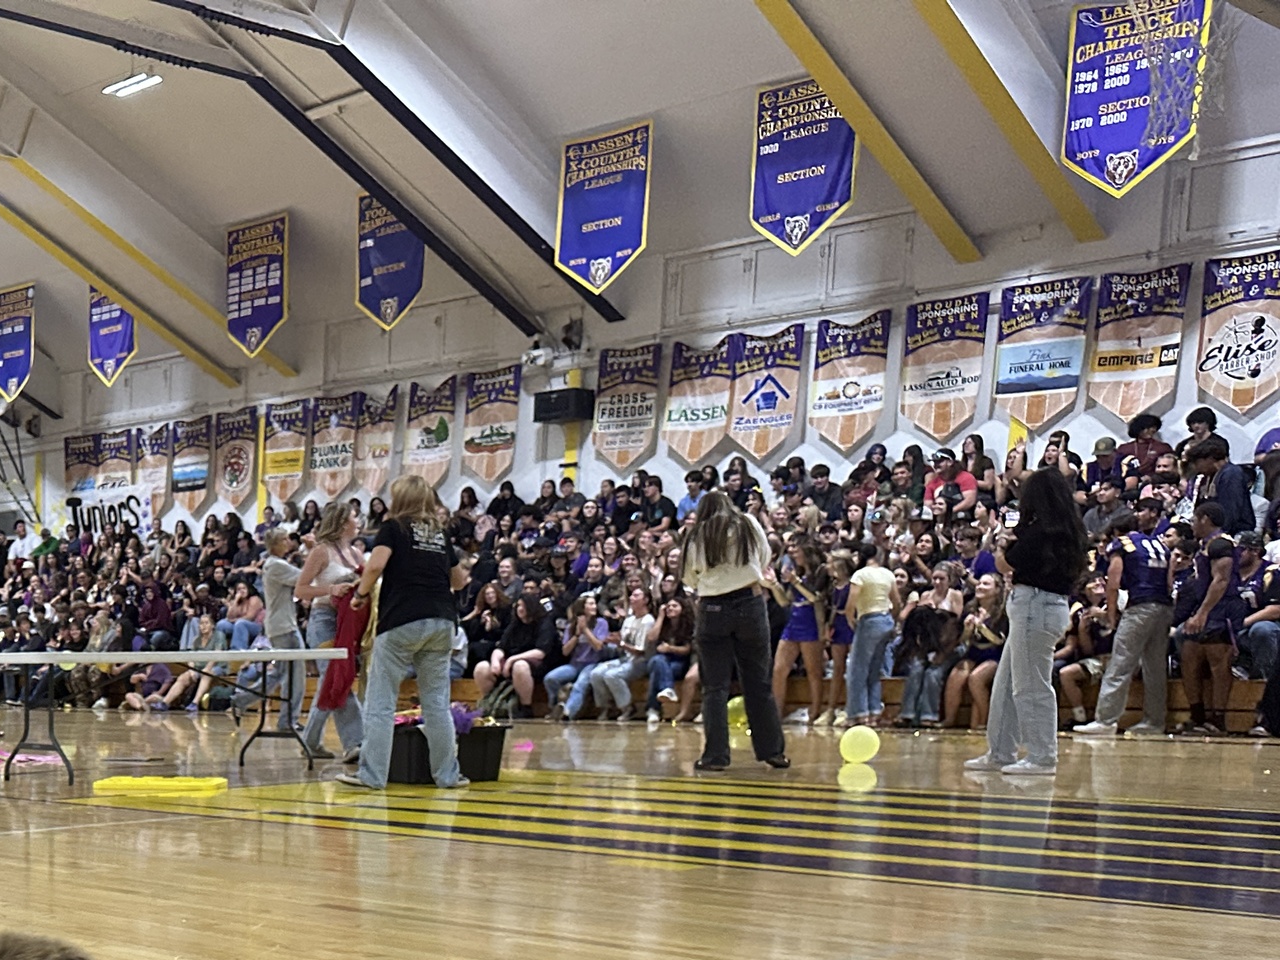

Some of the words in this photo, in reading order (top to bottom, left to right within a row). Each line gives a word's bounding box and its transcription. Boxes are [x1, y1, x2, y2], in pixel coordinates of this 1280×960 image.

[1104, 11, 1175, 39] TRACK
[1105, 43, 1164, 65] LEAG
[1075, 70, 1098, 82] 1964
[1105, 63, 1129, 77] 1965
[1104, 74, 1130, 90] 2000
[778, 83, 824, 102] LASS
[761, 97, 835, 123] X-COUNT
[1098, 95, 1157, 115] SECTIO
[759, 106, 843, 140] CHAMPIONSHI
[1100, 111, 1127, 126] 2000
[783, 122, 829, 140] LEAGUE
[582, 132, 633, 154] LASSEN
[569, 144, 642, 171] X-COUNTRY
[567, 155, 646, 187] CHAMPIONSHIPS
[777, 165, 826, 183] SECTION
[582, 216, 622, 233] SECTION
[1112, 268, 1179, 283] PROUDLY
[1219, 261, 1280, 277] SPONSORI
[1015, 280, 1080, 295] PROUDLY
[1111, 286, 1179, 300] LASSEN
[1112, 277, 1179, 292] SPONSORING
[1249, 284, 1260, 296] &
[917, 296, 978, 313] PROUDLY
[1012, 297, 1079, 312] LASSEN
[1013, 288, 1080, 304] SPONSORING
[917, 304, 978, 321] SPONSORING
[917, 312, 978, 328] LASSEN
[1161, 348, 1179, 361] CAT
[1199, 339, 1278, 372] Elise
[1219, 357, 1250, 372] BARBER
[1255, 350, 1277, 363] SHOP
[1009, 362, 1044, 374] FUNERAL
[1049, 361, 1071, 370] HOME
[903, 381, 932, 392] LASSEN
[936, 379, 958, 388] AUTO
[961, 374, 981, 384] BOD
[610, 392, 647, 405] CROSS
[601, 403, 652, 418] FREEDOM
[310, 457, 340, 469] BANK
[1141, 539, 1168, 568] 11
